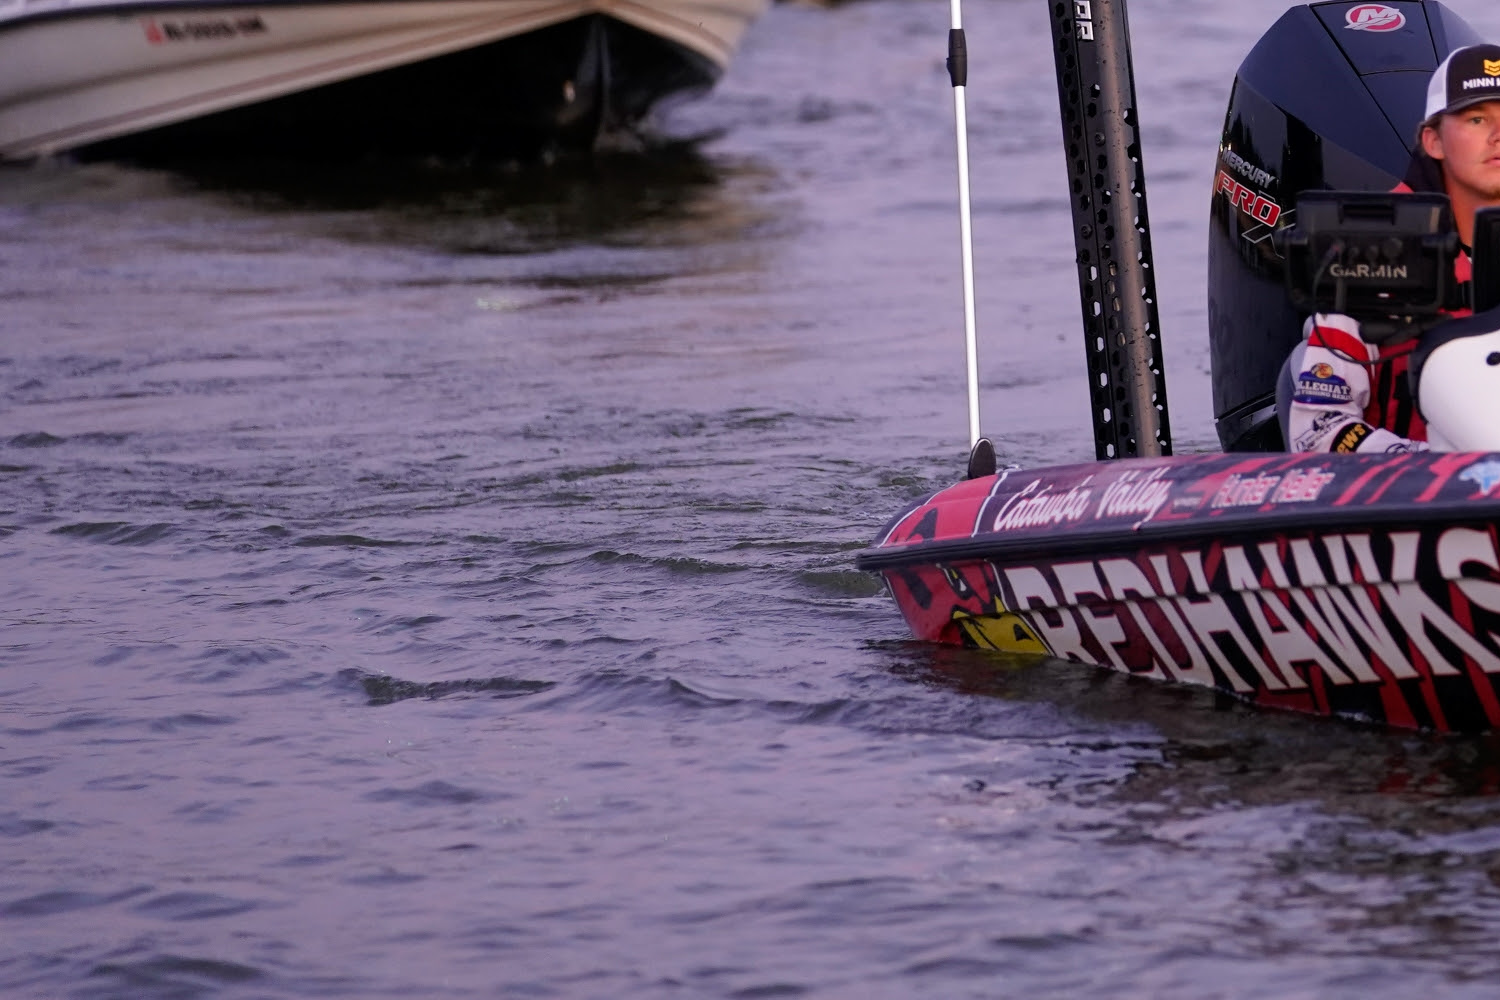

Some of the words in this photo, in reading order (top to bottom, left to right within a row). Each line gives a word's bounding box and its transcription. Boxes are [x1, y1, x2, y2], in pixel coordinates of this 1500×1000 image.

[1463, 78, 1495, 90] MINN
[1221, 146, 1277, 188] MERCURY
[1329, 263, 1408, 279] GARMIN
[993, 474, 1095, 532] Catawba
[1095, 466, 1174, 532] Valley
